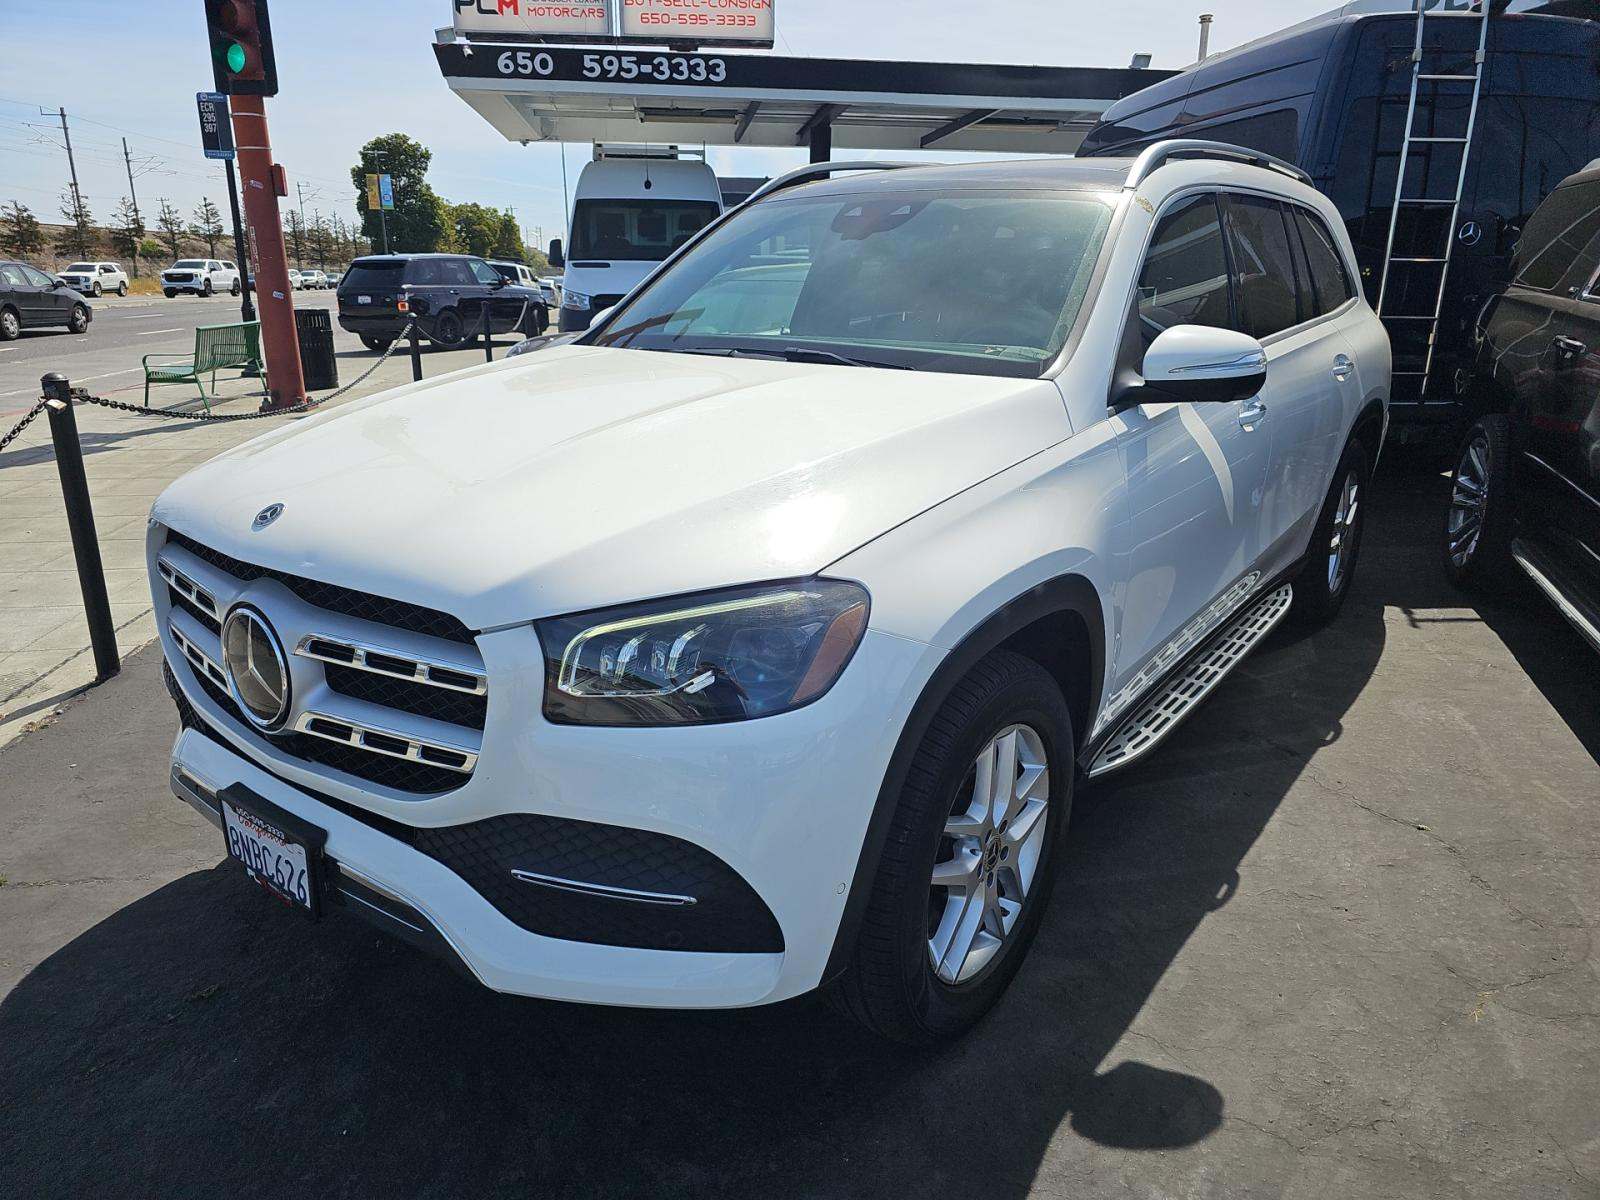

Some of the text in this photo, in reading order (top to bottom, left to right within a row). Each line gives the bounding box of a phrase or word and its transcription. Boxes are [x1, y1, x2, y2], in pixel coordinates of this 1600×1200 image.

[527, 6, 605, 18] MOTORCARS
[640, 12, 757, 27] 650-595-3333
[497, 51, 727, 82] 650 595-3333
[199, 102, 215, 112] ECR
[202, 112, 217, 123] 295
[204, 123, 217, 133] 397
[229, 825, 308, 905] 8NBC626
